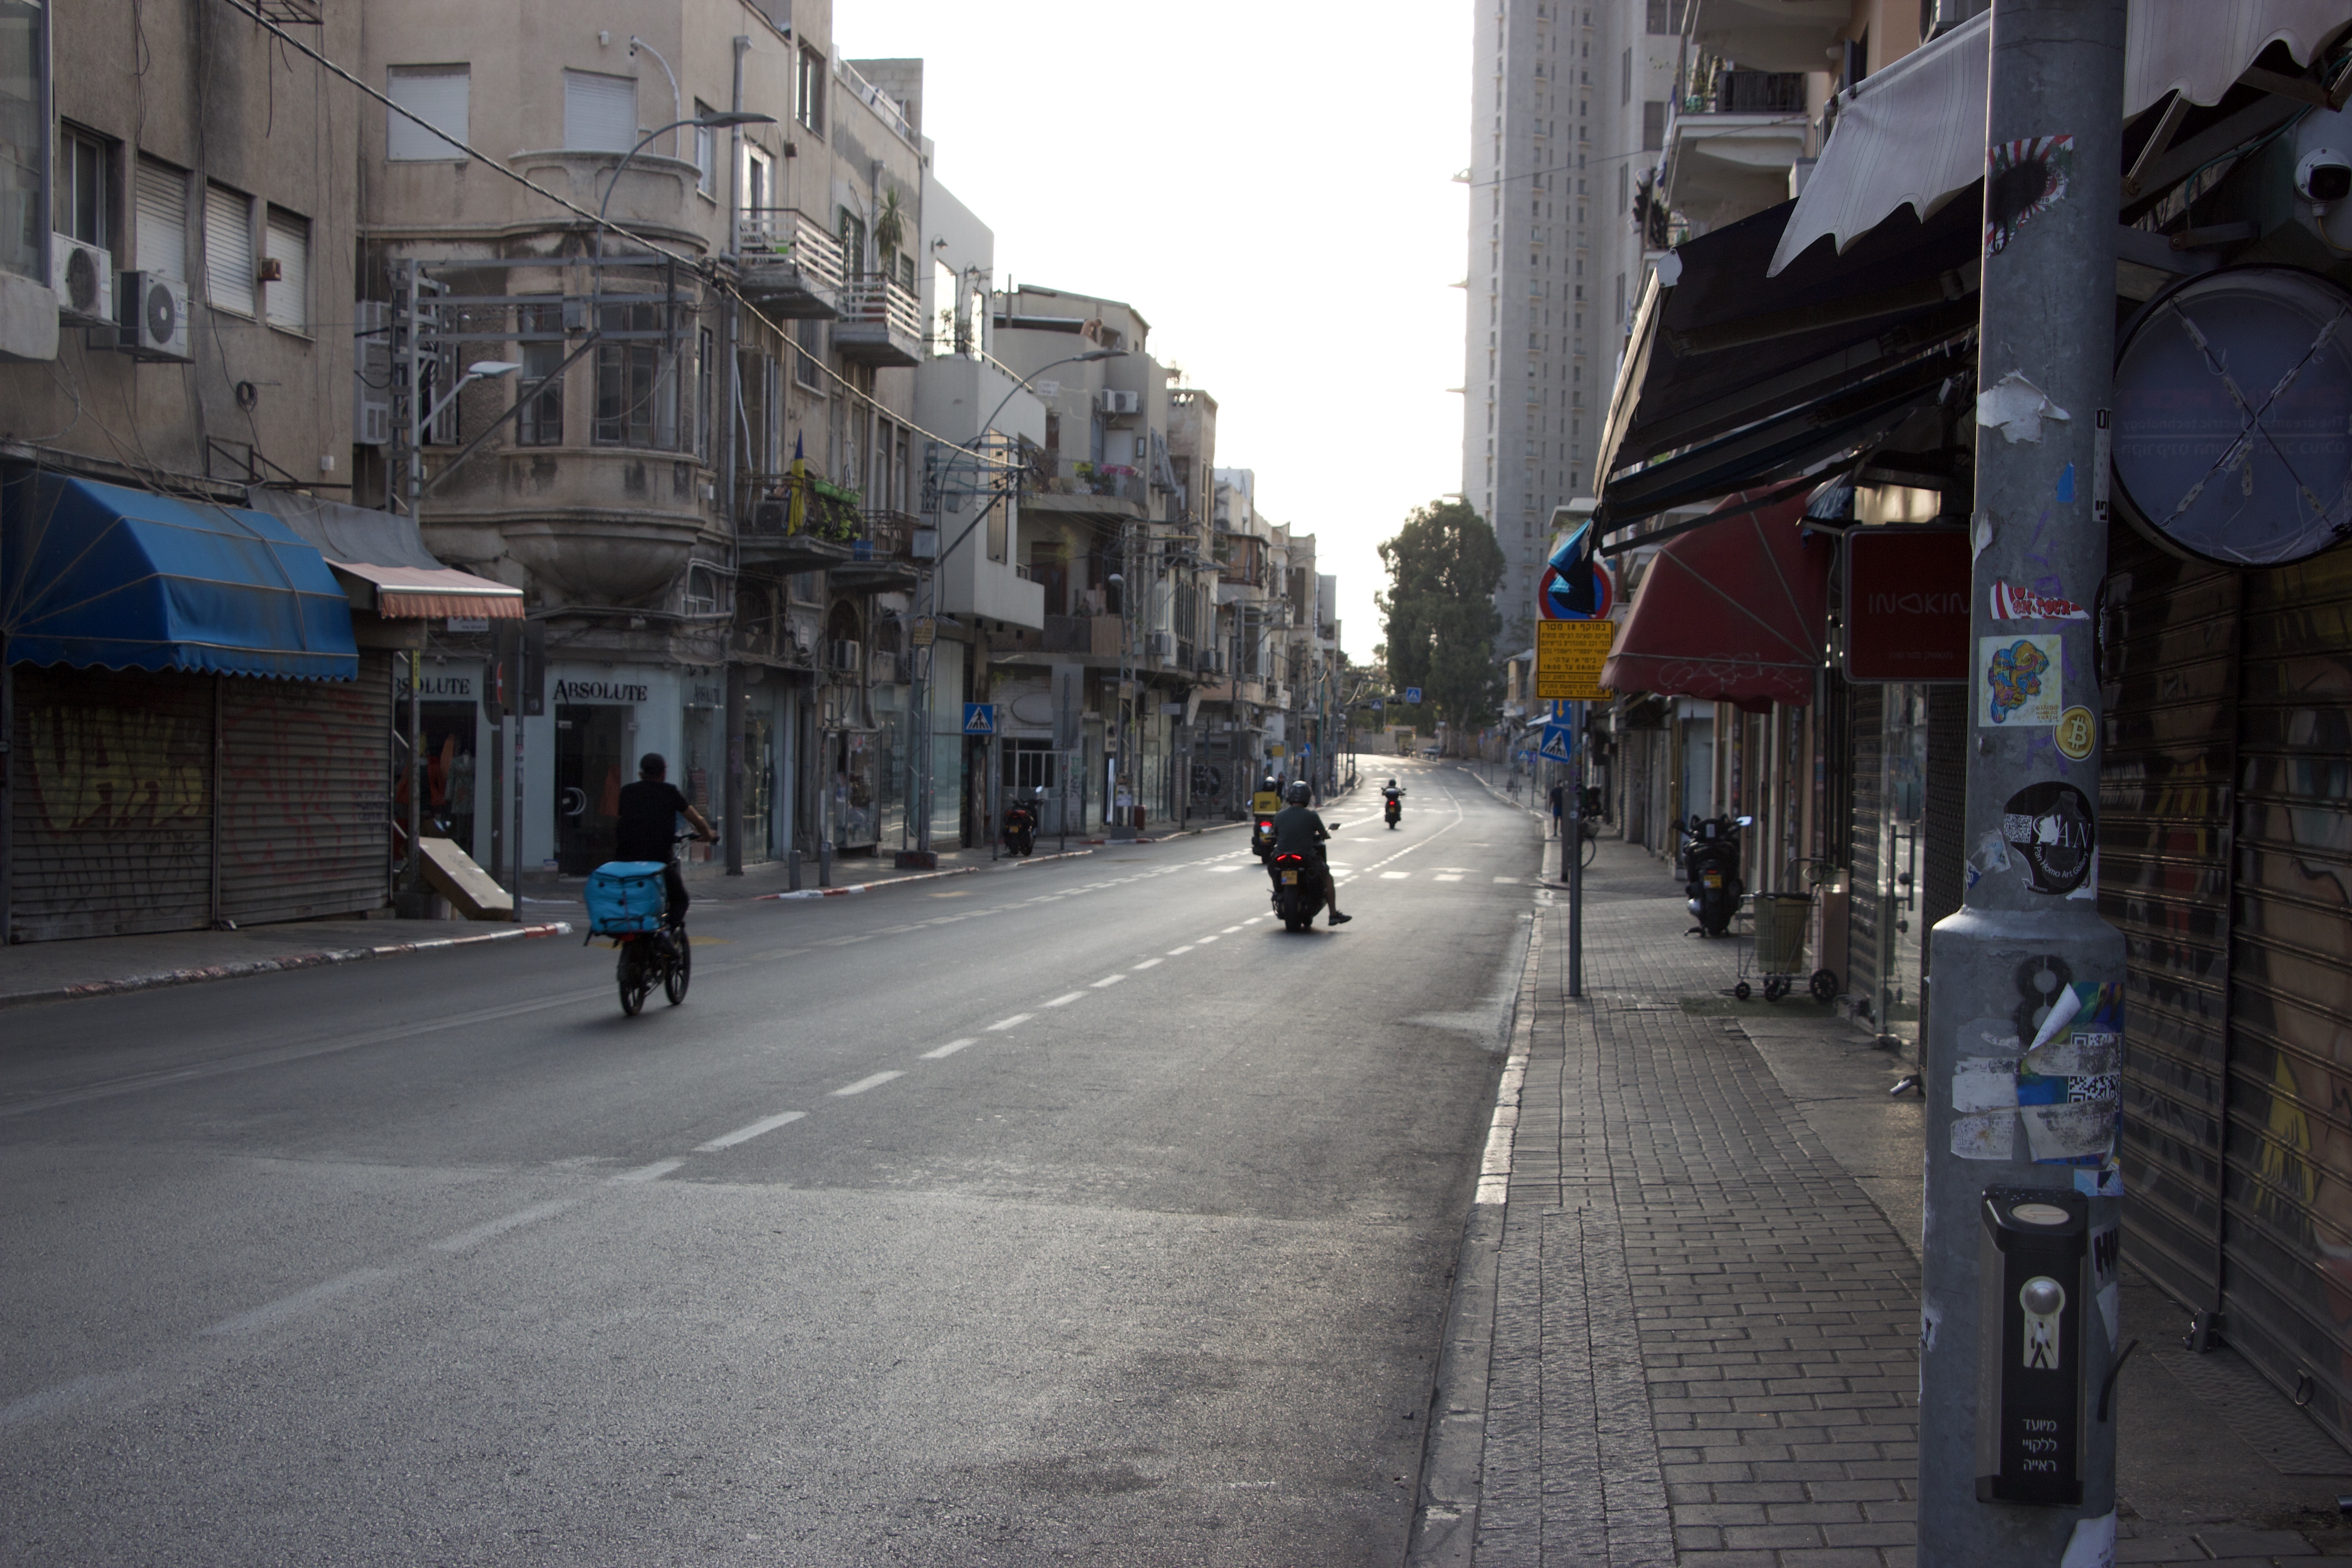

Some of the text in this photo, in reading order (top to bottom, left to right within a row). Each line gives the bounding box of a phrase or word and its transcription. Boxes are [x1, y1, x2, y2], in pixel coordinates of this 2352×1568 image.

[1870, 593, 1970, 613] INOKIN
[553, 680, 647, 705] ABSOLUTE
[2034, 846, 2088, 878] Pan Homo Art Gallery
[2023, 1419, 2057, 1431] מיועד
[2023, 1438, 2057, 1453] ללקויי
[2023, 1459, 2056, 1471] ראייה
